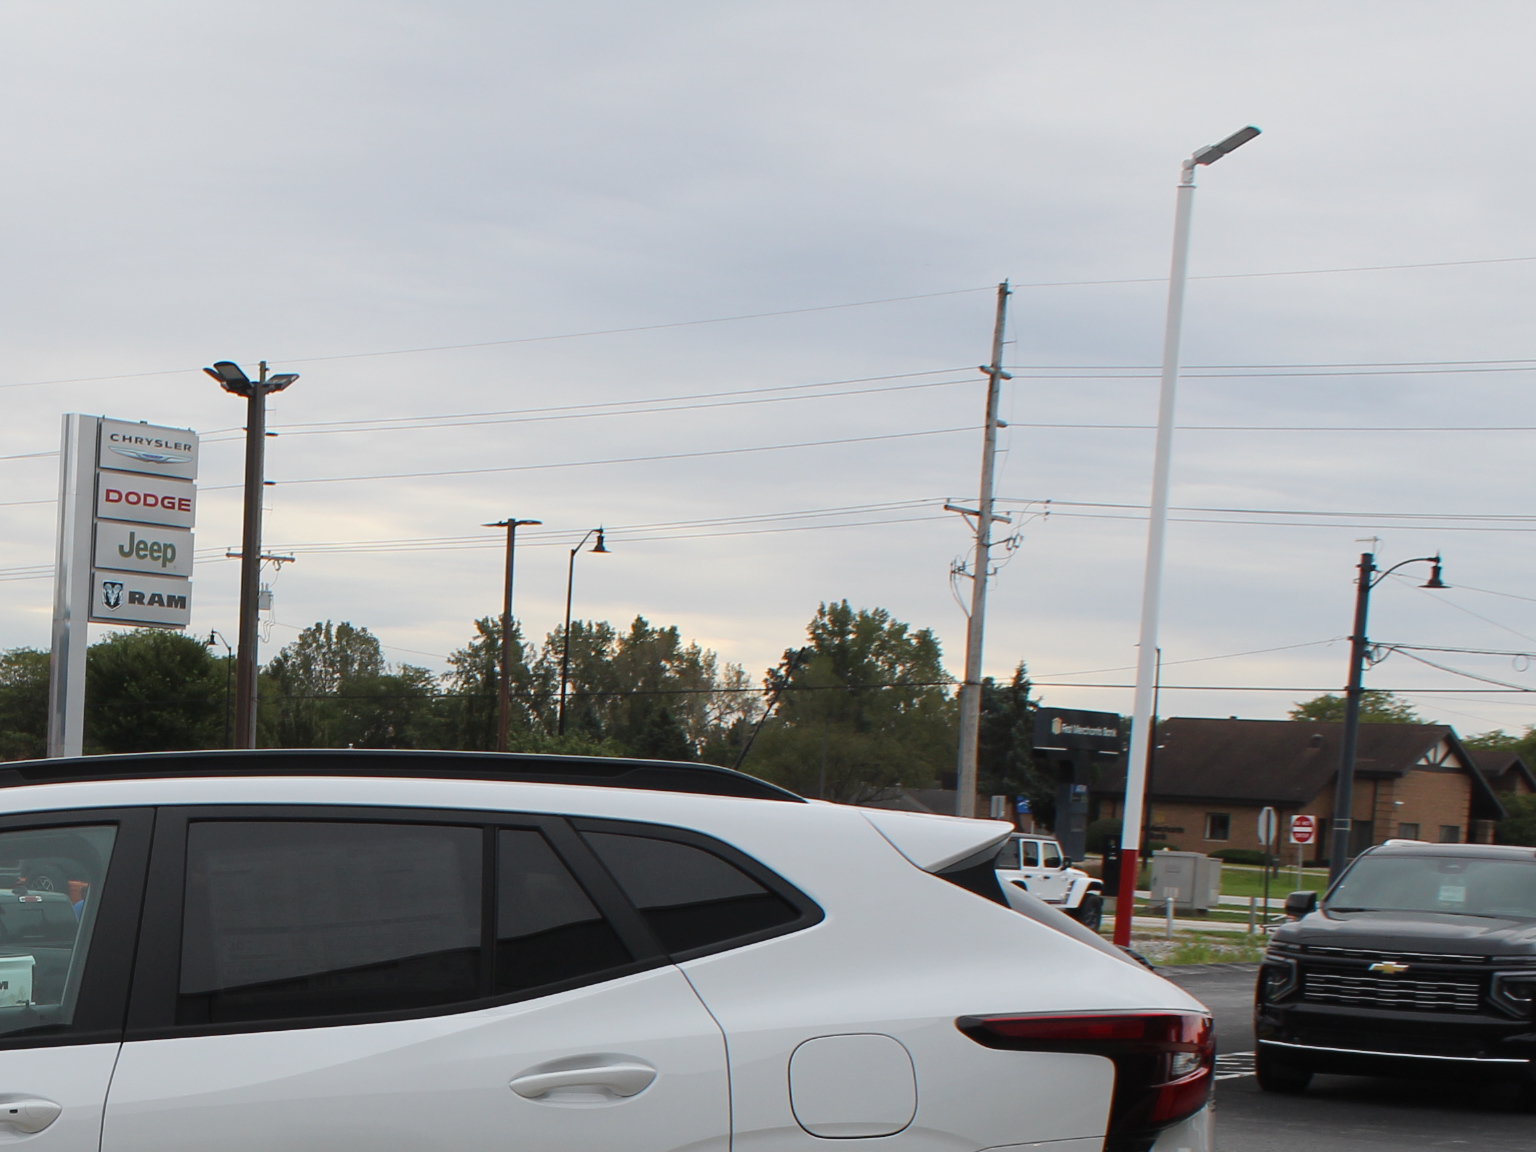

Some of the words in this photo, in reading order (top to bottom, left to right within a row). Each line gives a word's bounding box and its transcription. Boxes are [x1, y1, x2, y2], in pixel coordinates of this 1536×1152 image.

[110, 433, 192, 452] CHRYSLER
[105, 488, 192, 512] DODGE
[118, 531, 176, 568] Jeep
[128, 590, 187, 610] RAM
